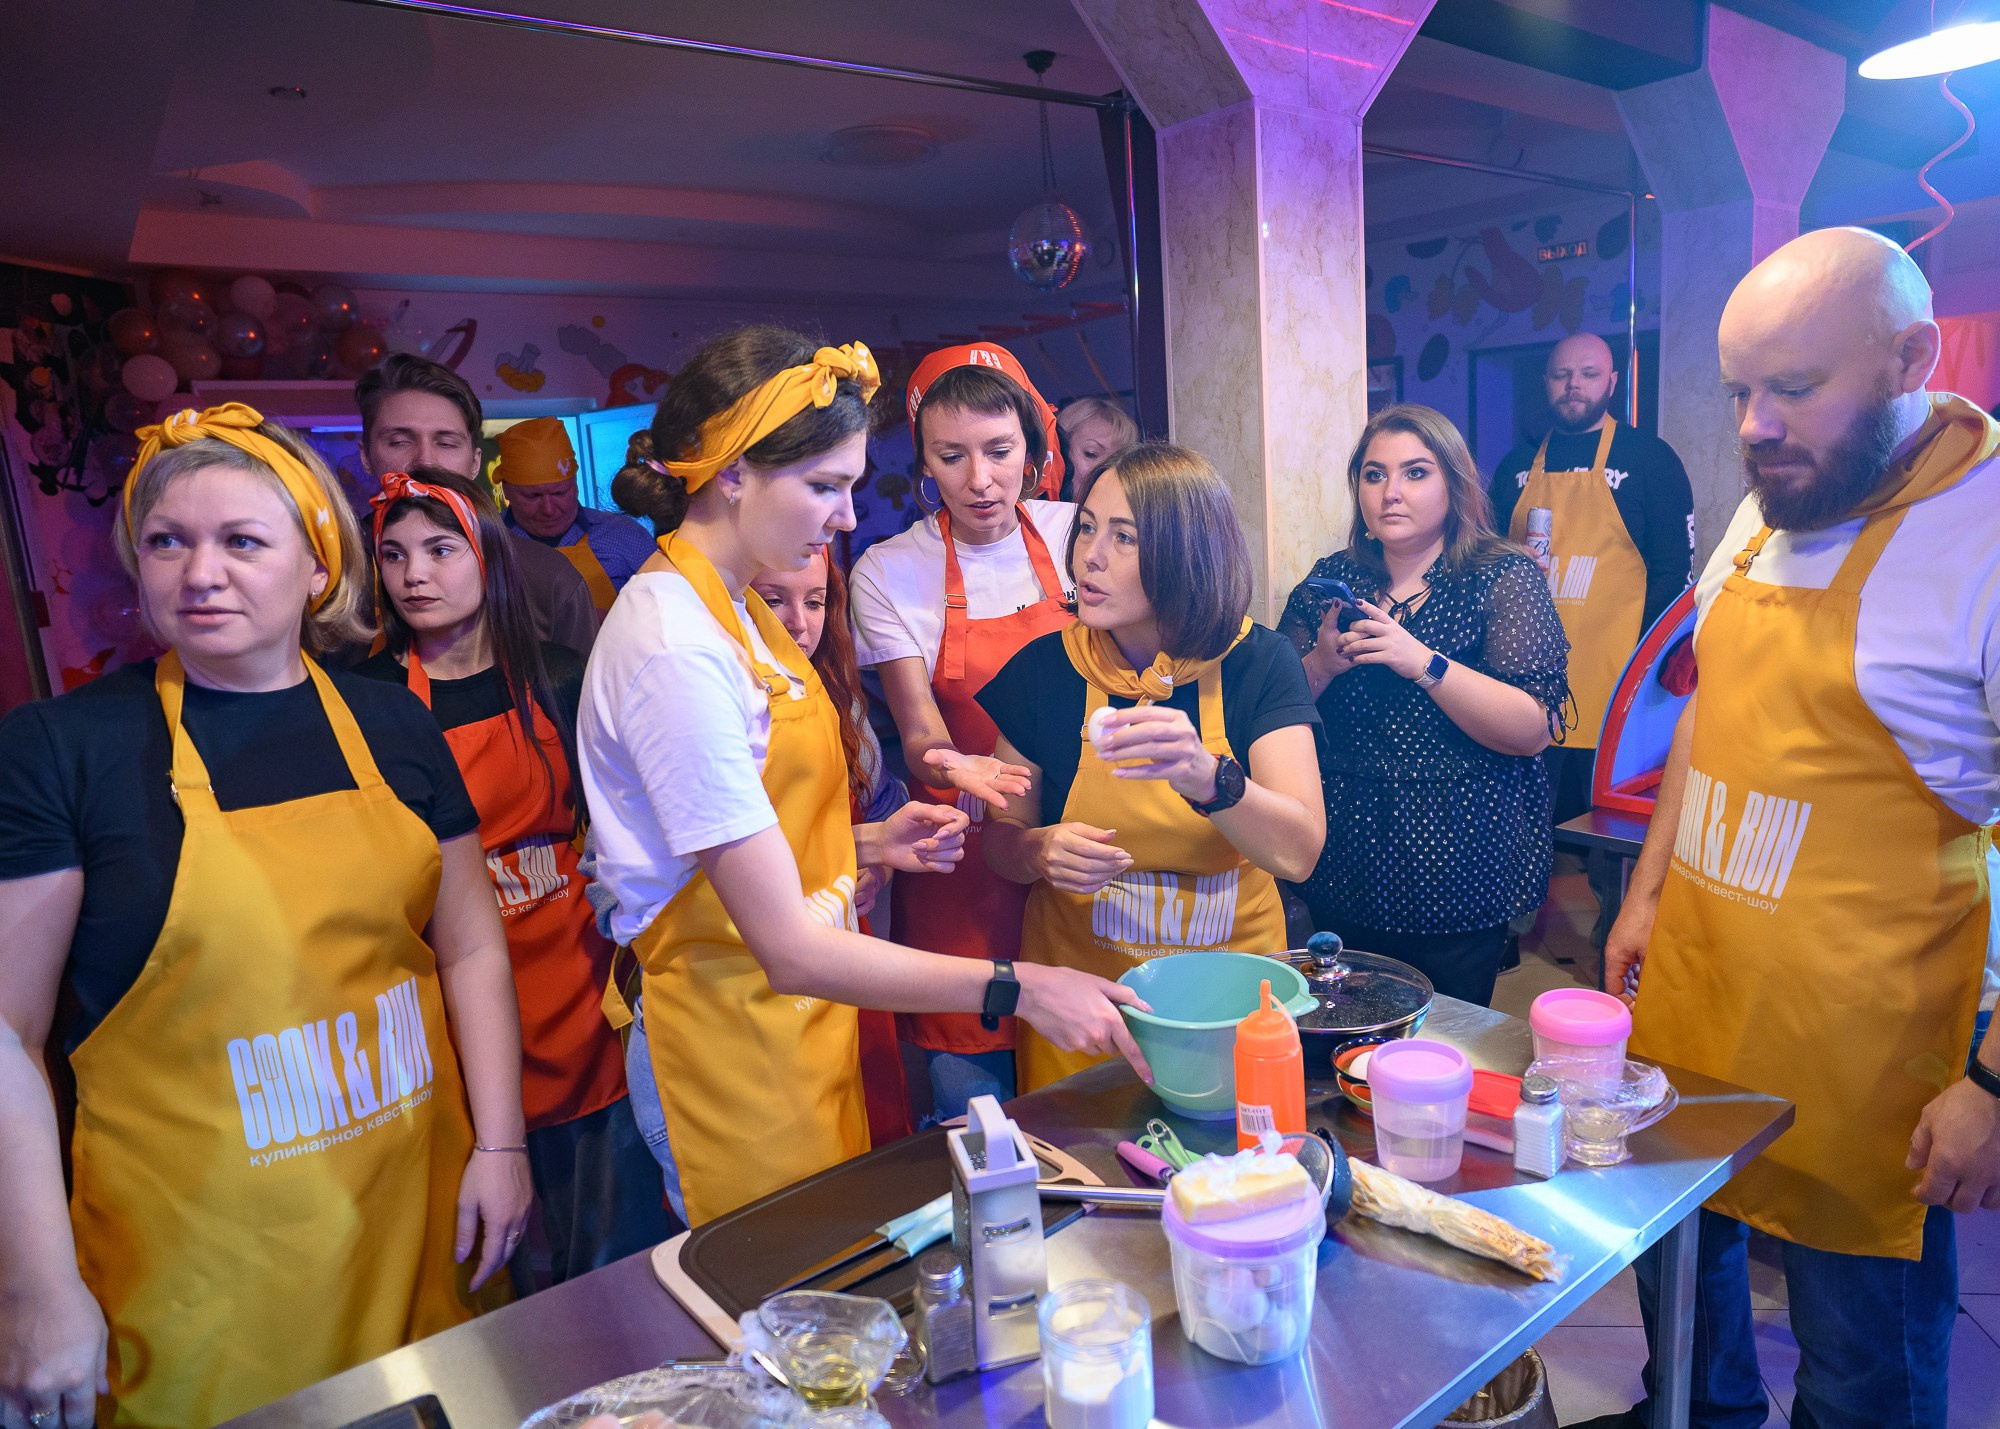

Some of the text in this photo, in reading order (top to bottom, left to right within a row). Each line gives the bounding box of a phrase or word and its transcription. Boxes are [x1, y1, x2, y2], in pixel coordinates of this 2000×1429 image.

[1560, 555, 1598, 600] RUN
[1703, 780, 1727, 881] &
[1722, 790, 1813, 899] RUN
[1160, 870, 1185, 946] &
[1185, 867, 1240, 947] RUN
[1707, 882, 1779, 915] квест-шоу
[1094, 938, 1166, 958] кулинарное
[226, 976, 434, 1150] COOK & RUN
[250, 1085, 433, 1167] кулинарное квест-шоу
